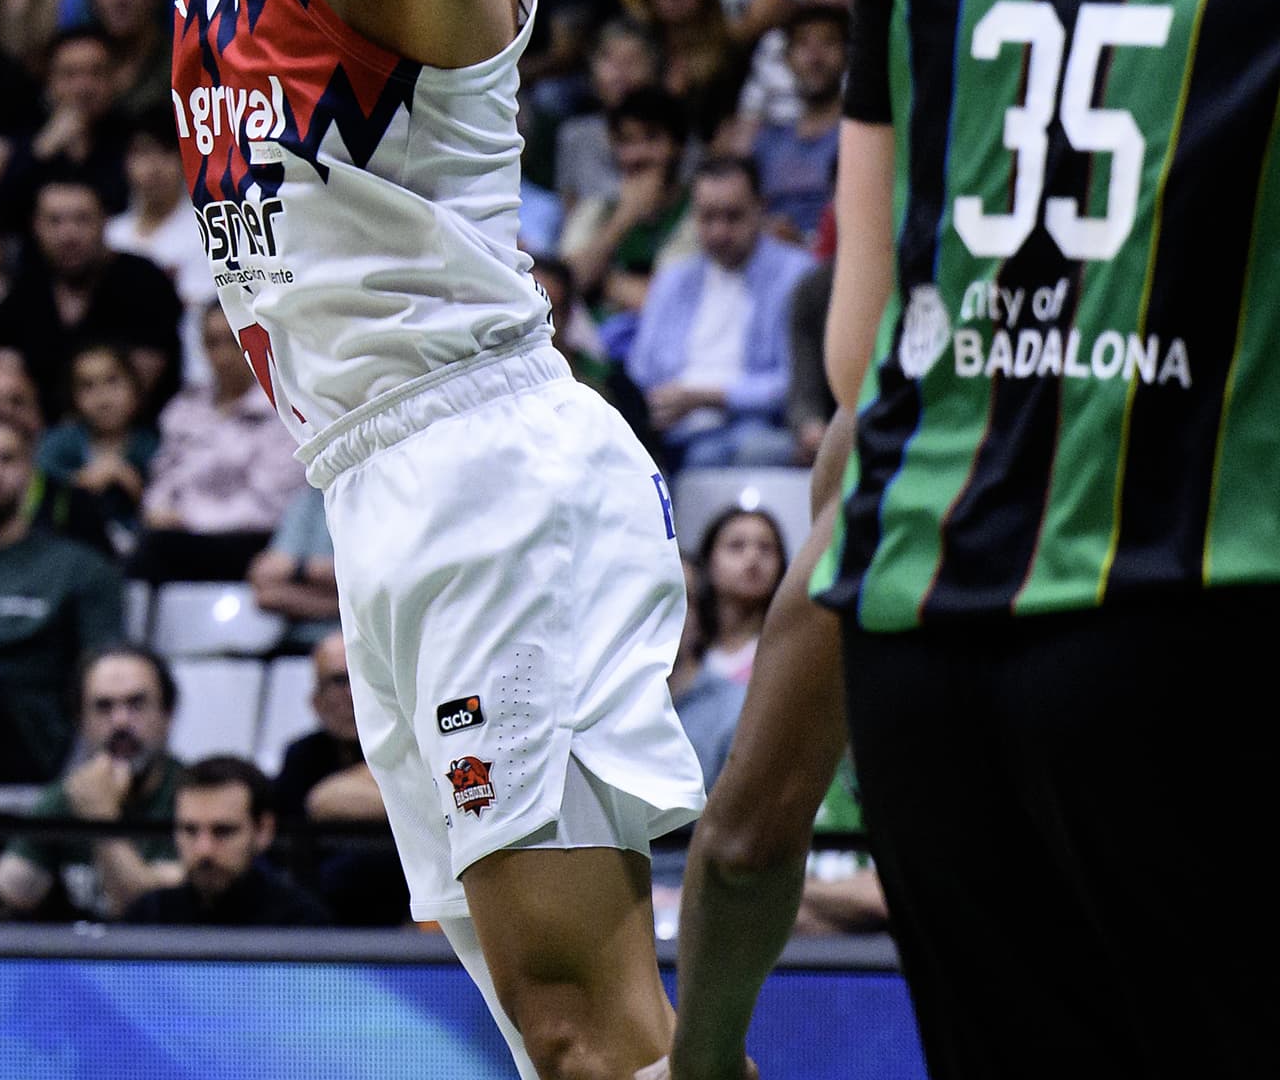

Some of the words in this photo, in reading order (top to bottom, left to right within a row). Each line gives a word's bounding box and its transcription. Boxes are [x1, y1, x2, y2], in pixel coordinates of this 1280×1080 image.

[953, 0, 1174, 260] 35
[1032, 277, 1070, 321] of
[953, 328, 1192, 388] BADALONA
[441, 710, 473, 730] acb
